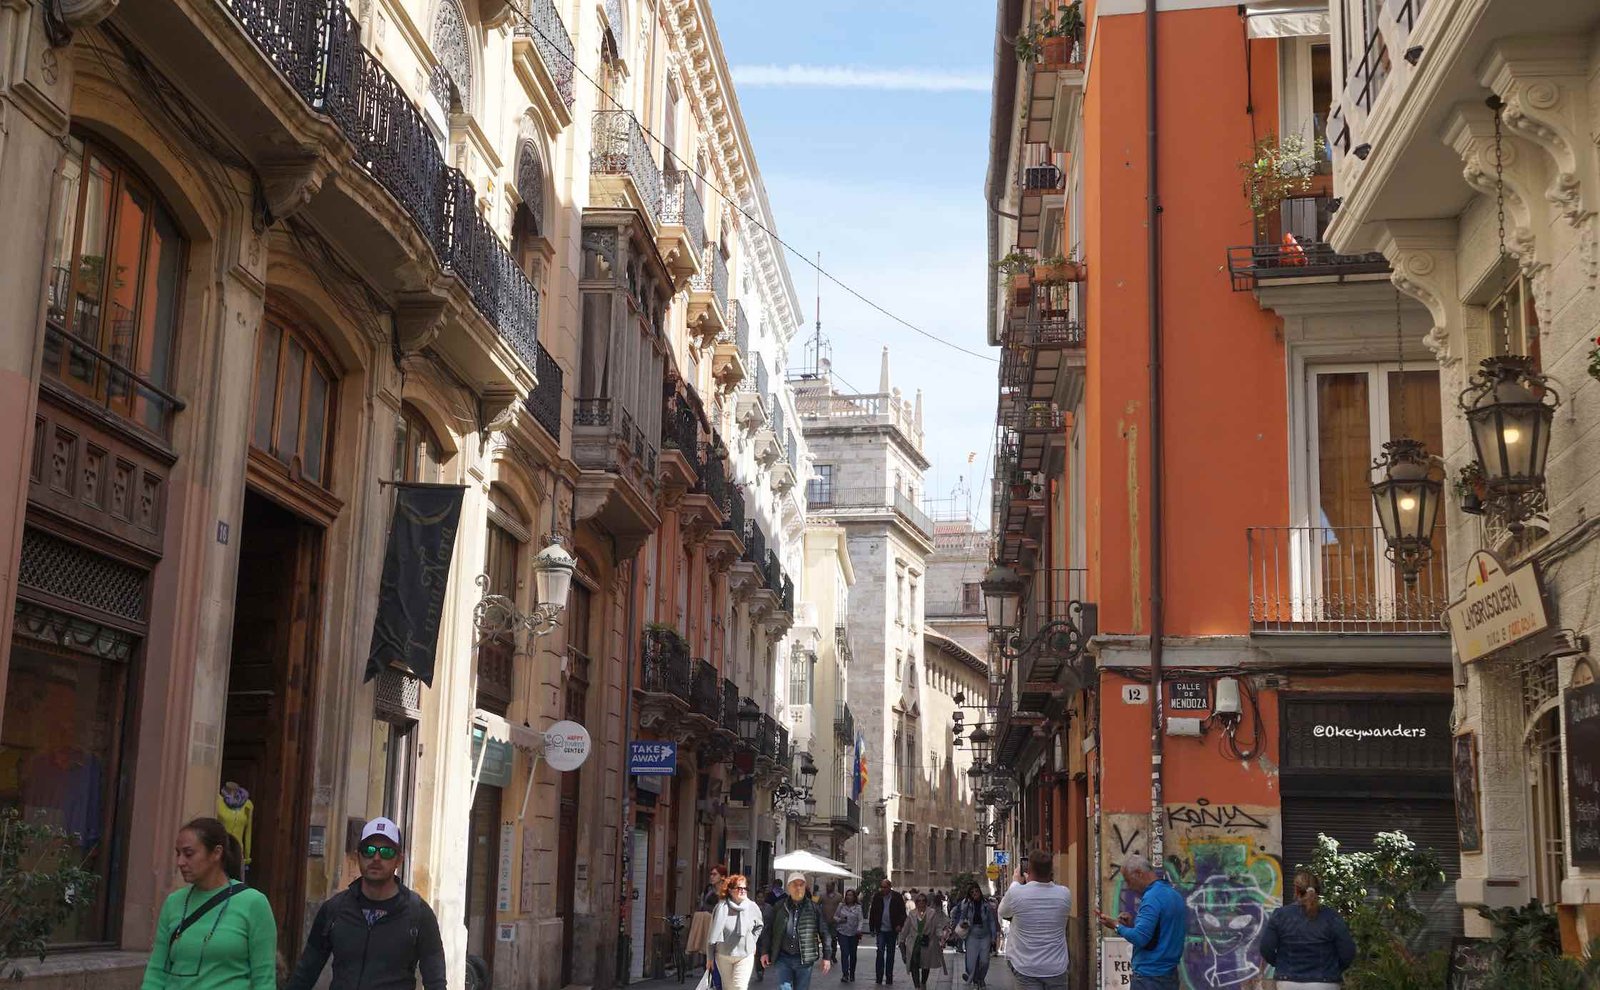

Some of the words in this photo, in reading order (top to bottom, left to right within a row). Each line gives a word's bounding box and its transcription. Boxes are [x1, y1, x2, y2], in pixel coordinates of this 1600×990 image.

[1129, 689, 1141, 701] 12
[1171, 698, 1207, 709] MENDOZA
[631, 745, 660, 753] TAKE
[631, 754, 660, 763] AWAY
